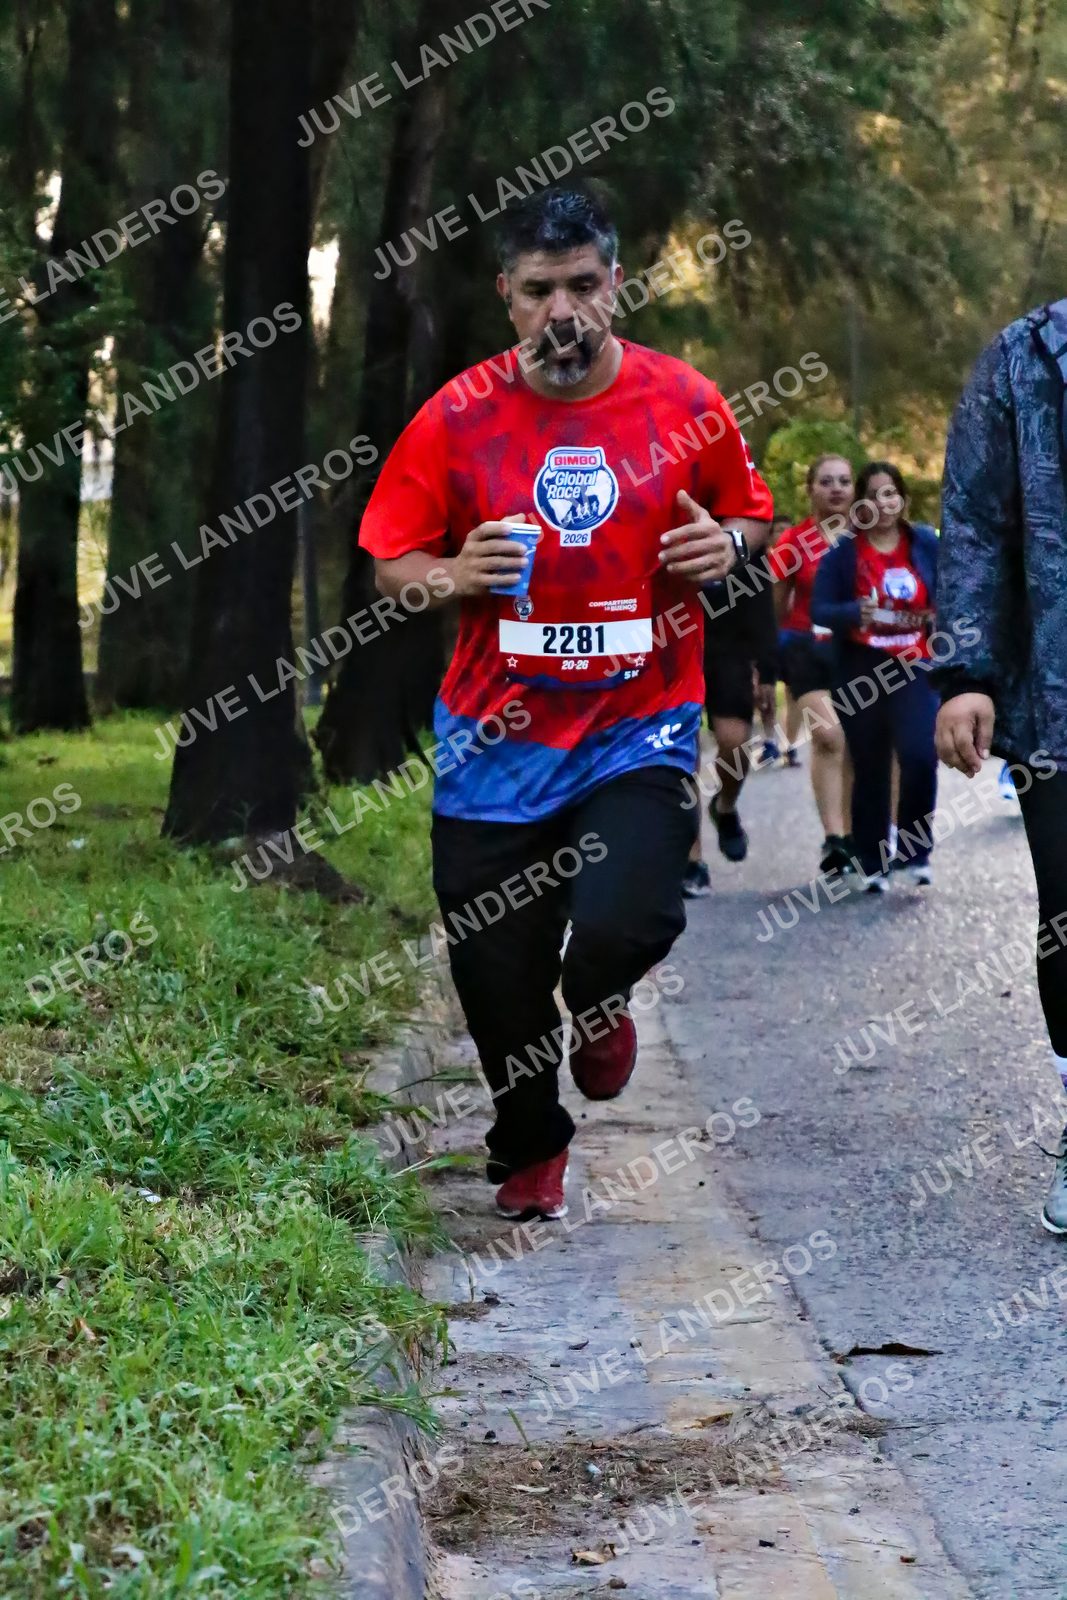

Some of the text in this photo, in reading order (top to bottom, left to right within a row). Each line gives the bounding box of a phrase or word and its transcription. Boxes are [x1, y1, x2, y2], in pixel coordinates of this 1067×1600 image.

[554, 455, 597, 466] BIMBO
[555, 471, 598, 486] Global
[546, 485, 581, 499] Race
[563, 533, 588, 544] 2026
[542, 625, 605, 654] 2281
